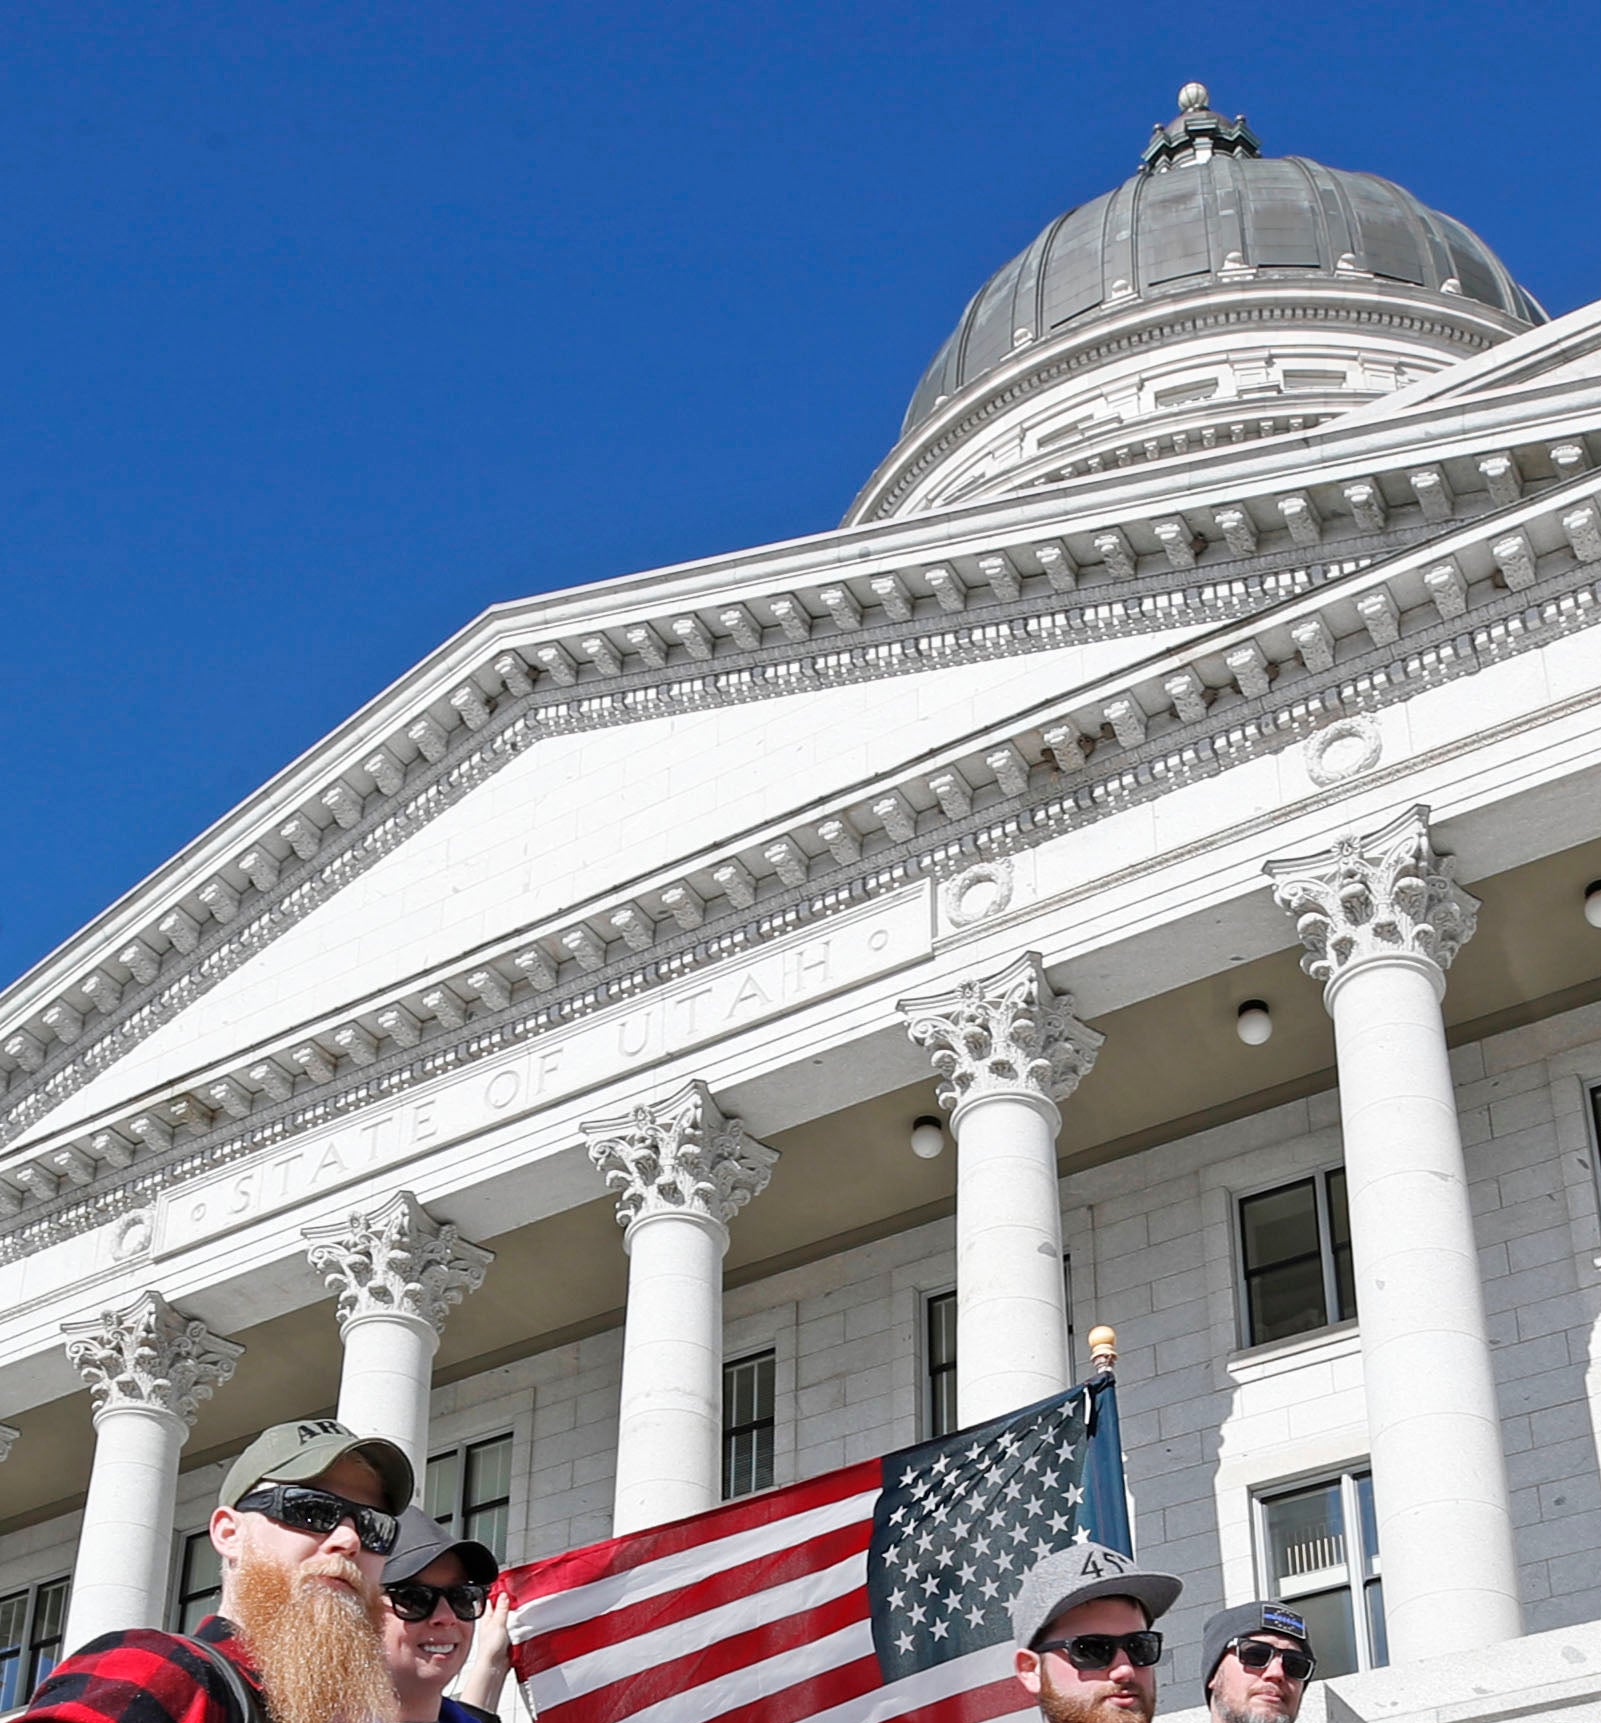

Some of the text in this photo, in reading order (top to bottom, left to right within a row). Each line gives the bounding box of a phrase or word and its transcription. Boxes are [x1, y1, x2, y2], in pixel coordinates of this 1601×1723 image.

[229, 939, 833, 1215] STATE OF UTAH
